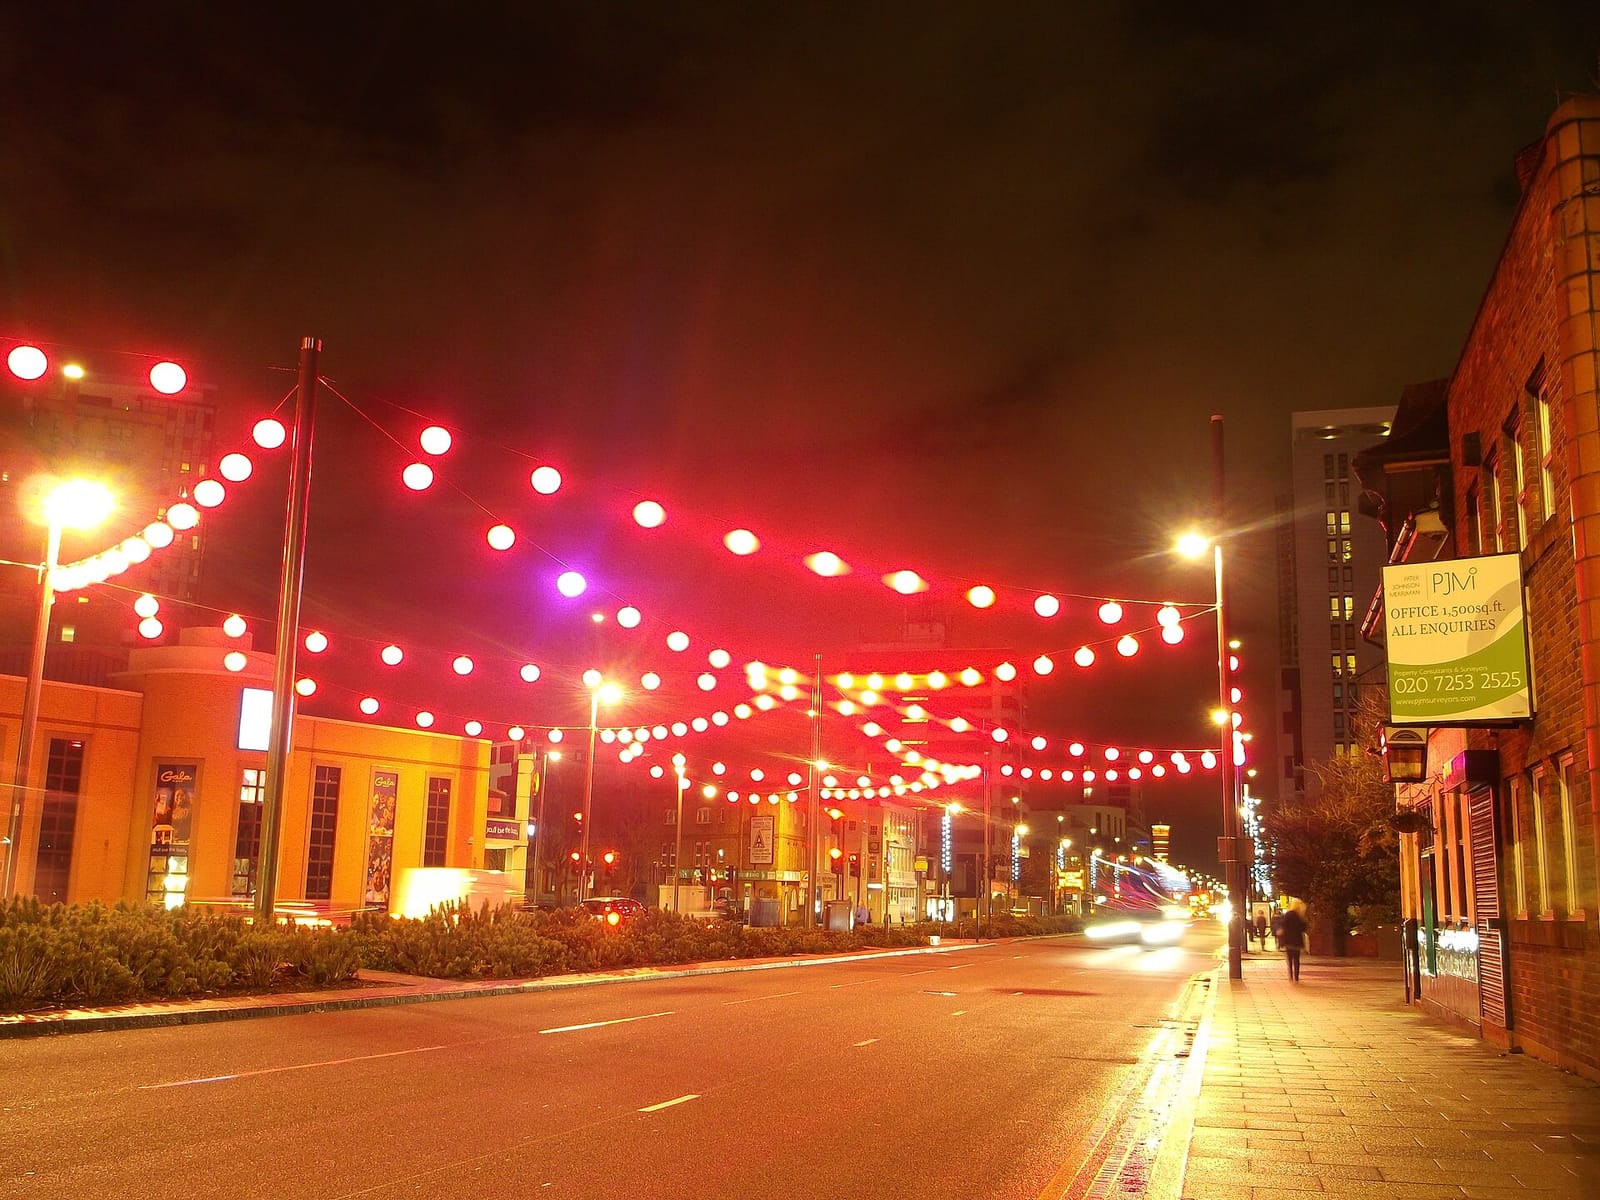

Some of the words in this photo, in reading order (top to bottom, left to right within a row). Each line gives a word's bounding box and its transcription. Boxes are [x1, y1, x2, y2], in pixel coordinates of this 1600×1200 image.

[1392, 582, 1420, 591] JOHNSON
[1390, 606, 1438, 619] OFFICE
[1442, 600, 1506, 618] 1,500sq.ft.
[1392, 624, 1417, 636] ALL
[1420, 619, 1496, 635] ENQUIRIES
[1420, 667, 1453, 676] Consultants
[1460, 666, 1488, 674] Surveyors
[1394, 677, 1428, 694] 020
[1434, 674, 1474, 692] 7253
[1480, 672, 1521, 689] 2525
[1396, 696, 1476, 706] www.pjmsurveyors.com
[160, 770, 192, 782] Gala
